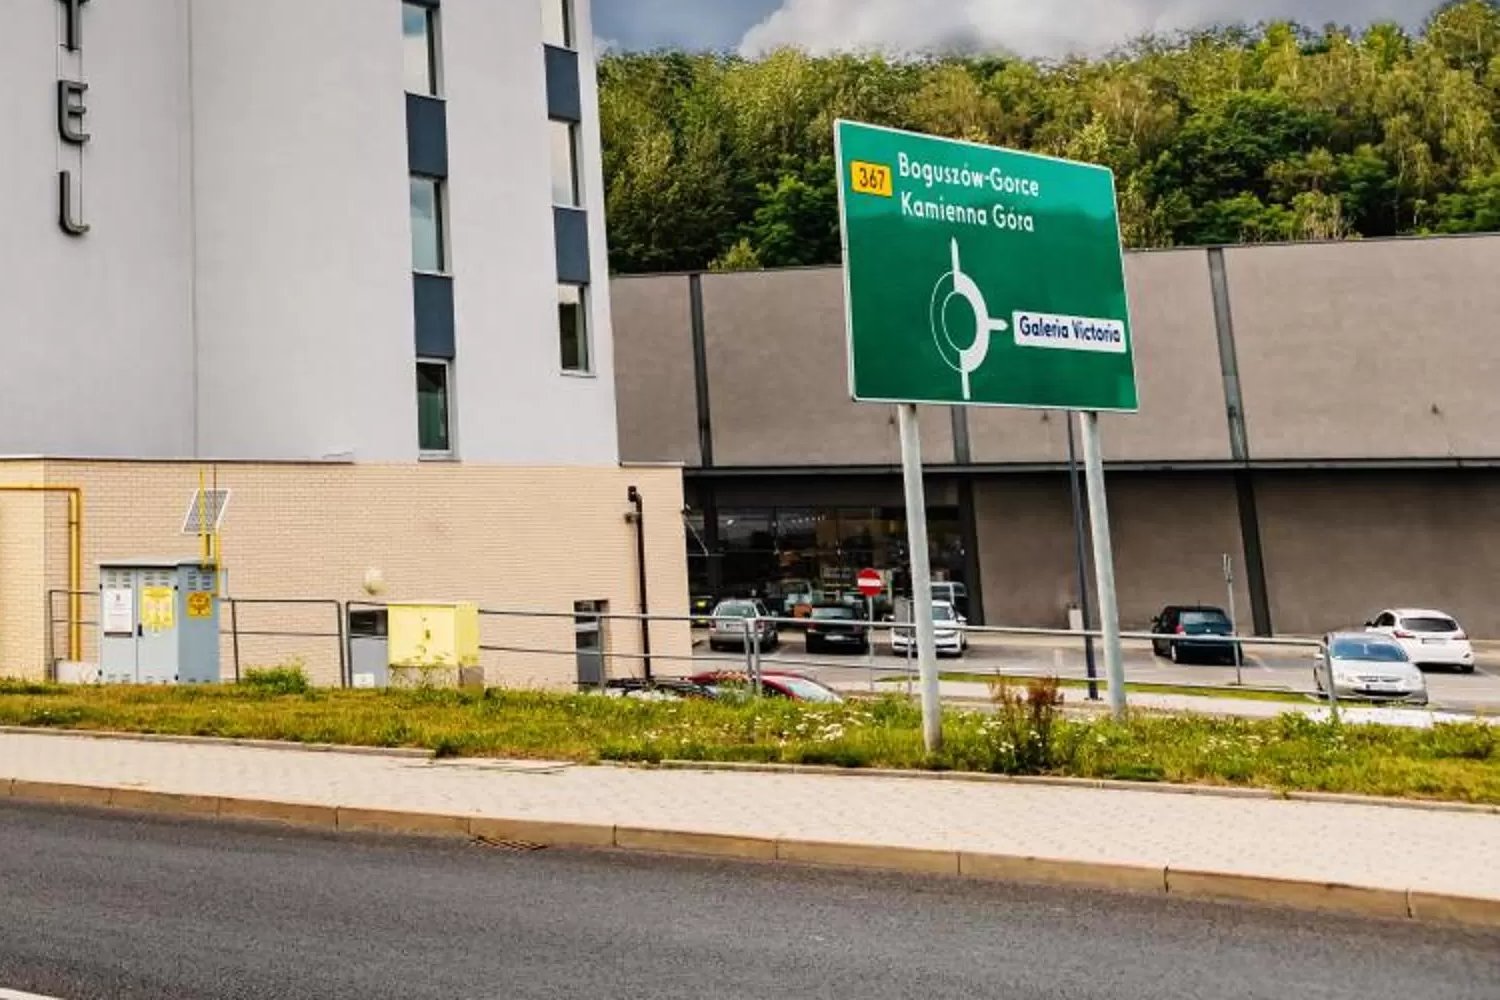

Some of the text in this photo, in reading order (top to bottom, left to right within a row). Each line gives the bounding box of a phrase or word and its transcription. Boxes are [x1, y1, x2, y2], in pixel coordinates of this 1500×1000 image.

[858, 167, 886, 191] 367
[897, 151, 1040, 197] Boguszów-Gorce
[900, 191, 1035, 232] Kamienna Góra
[1019, 315, 1121, 343] Galeria Victoria
